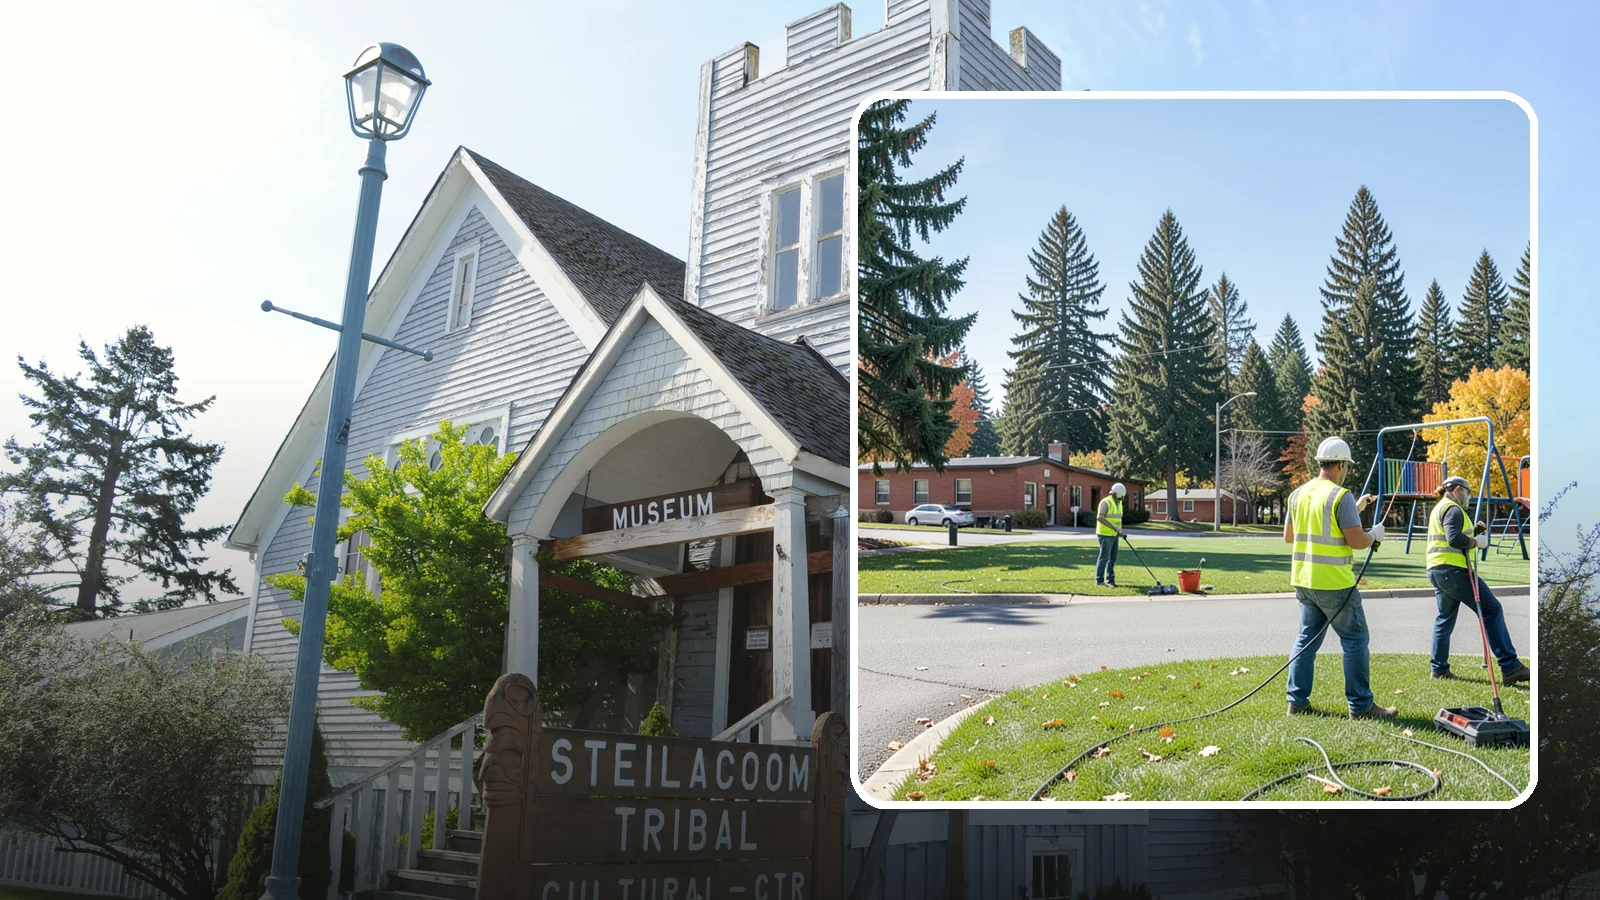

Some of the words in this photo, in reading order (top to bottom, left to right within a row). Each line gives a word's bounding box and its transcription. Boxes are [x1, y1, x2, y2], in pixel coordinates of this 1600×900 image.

[612, 491, 714, 531] MUSEUM
[550, 738, 810, 793] STEILACOOM
[614, 806, 758, 852] TRIBAL
